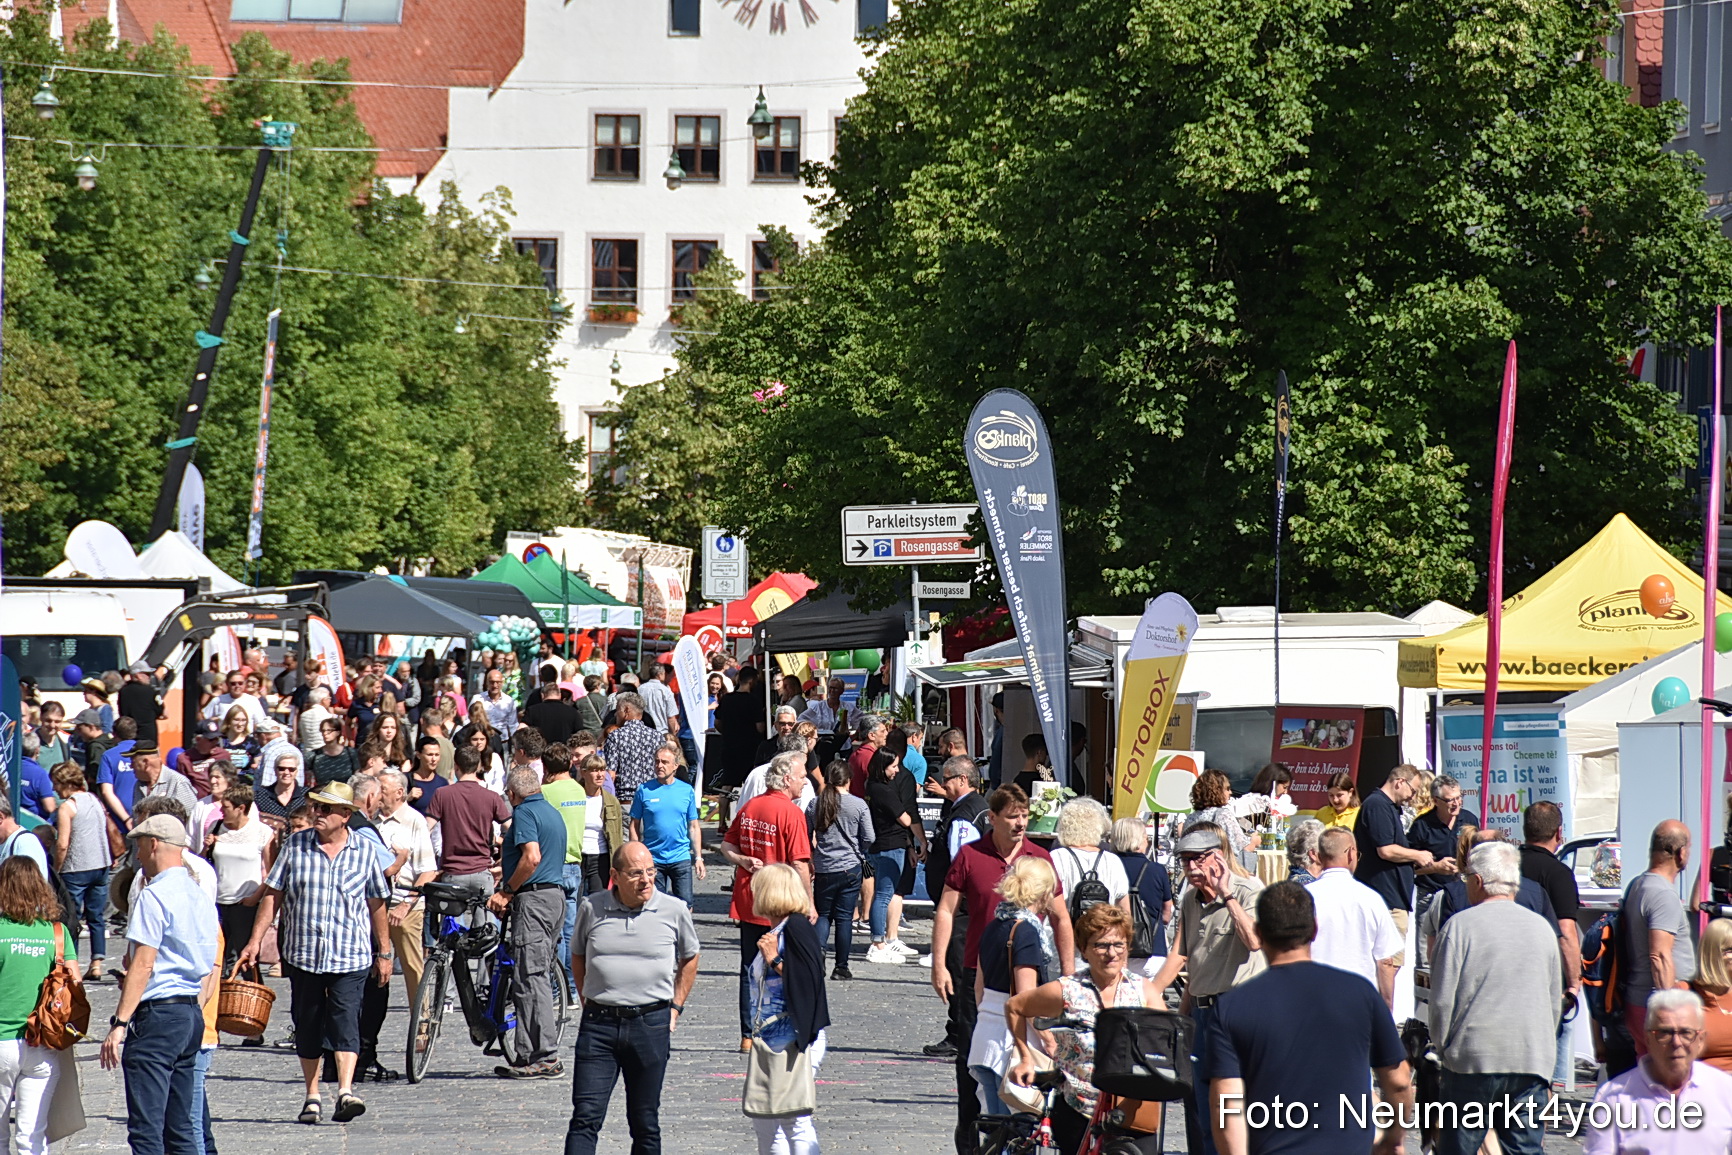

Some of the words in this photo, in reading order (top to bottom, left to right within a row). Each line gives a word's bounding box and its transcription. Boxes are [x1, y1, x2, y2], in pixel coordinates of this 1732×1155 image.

[868, 513, 957, 531] Parkleitsystem
[901, 540, 960, 554] Rosengasse
[922, 585, 965, 597] Rosengasse
[210, 612, 249, 620] VOLVO
[1577, 623, 1615, 633] Bäckerei
[1657, 621, 1700, 631] Konditorei
[1145, 630, 1179, 644] Doktorshof
[1659, 692, 1677, 708] ha!
[1121, 668, 1171, 796] FOTOBOX
[1451, 744, 1472, 752] Nous
[1505, 742, 1519, 750] toi!
[1514, 751, 1545, 760] Chceme
[1295, 762, 1307, 774] bin
[1308, 762, 1320, 774] ich
[1320, 763, 1350, 775] Mensch
[1445, 759, 1459, 768] Wir
[1461, 759, 1483, 767] wolle
[1537, 765, 1550, 774] We
[1513, 765, 1534, 783] ist
[1538, 776, 1558, 784] want
[1290, 780, 1307, 791] kann
[1309, 780, 1321, 792] ich
[1539, 786, 1556, 796] you!
[11, 944, 46, 957] Pflege
